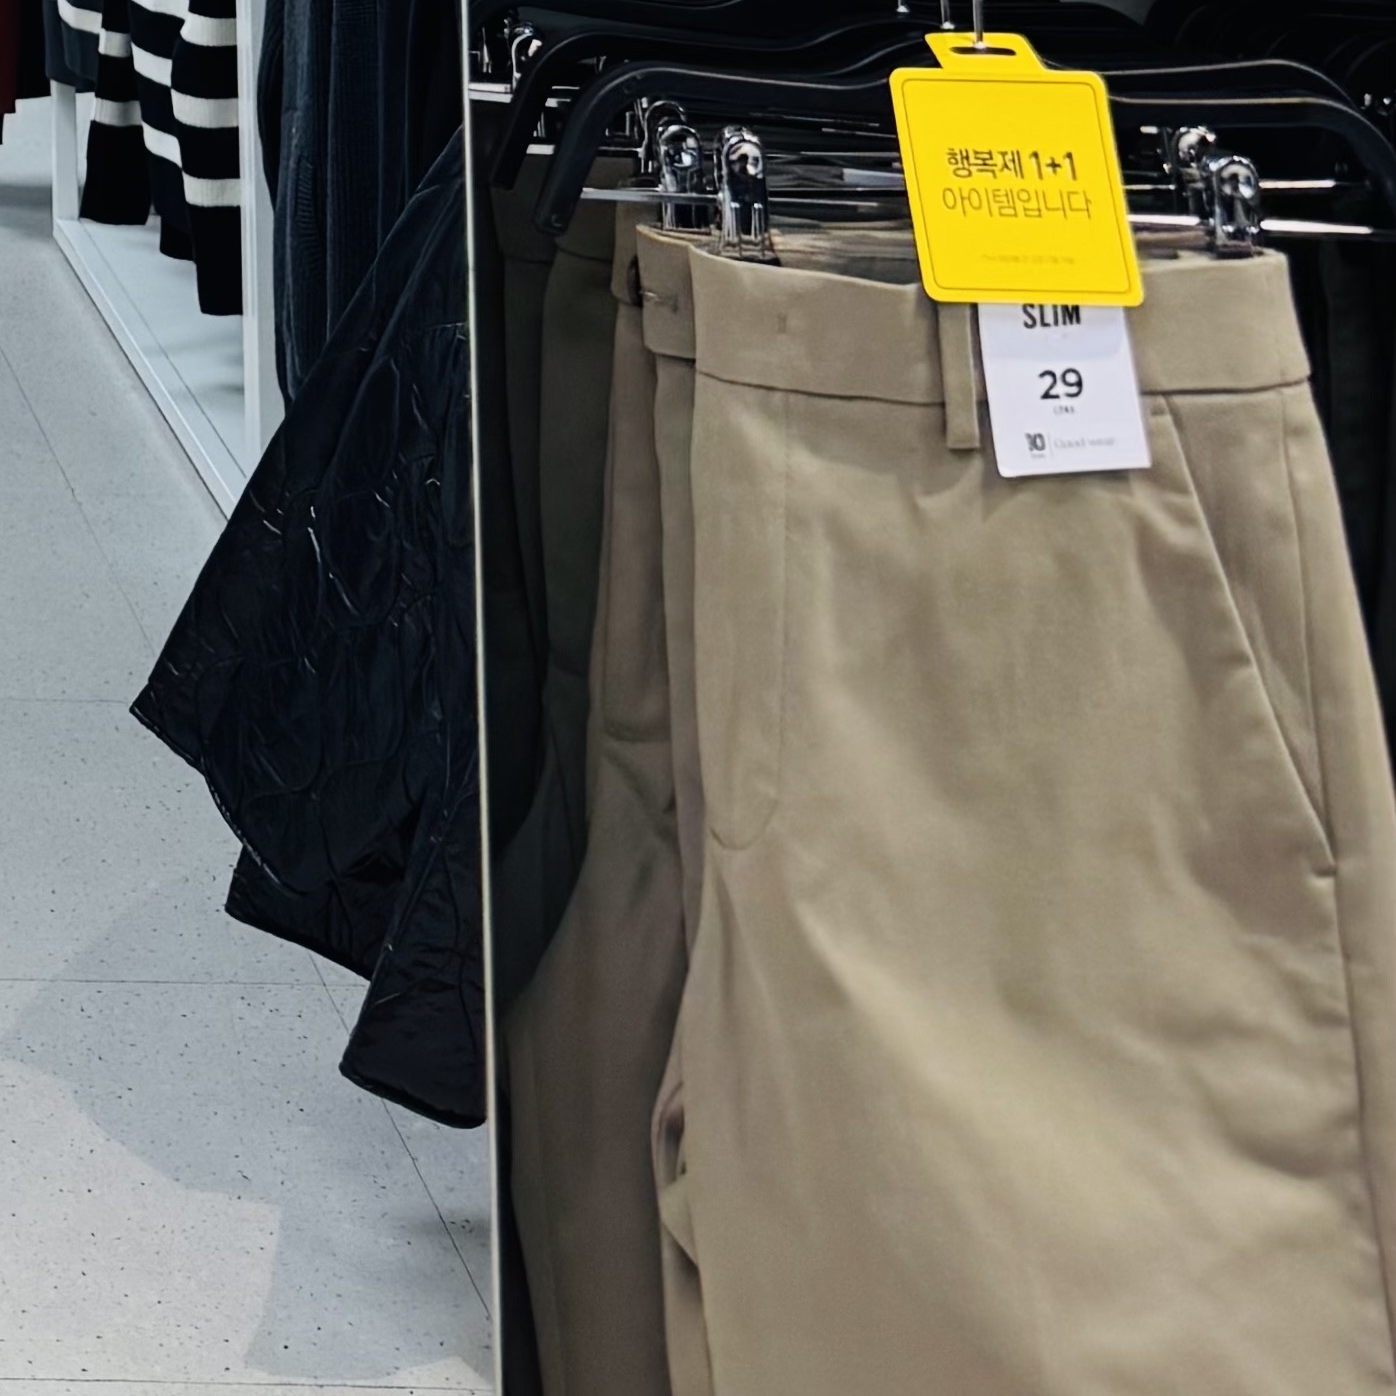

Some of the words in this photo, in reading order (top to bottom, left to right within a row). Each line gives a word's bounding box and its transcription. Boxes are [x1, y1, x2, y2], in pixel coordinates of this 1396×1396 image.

[945, 147, 1025, 180] 행복제
[1028, 150, 1078, 182] 1+1
[942, 186, 1093, 220] 아이템입니다
[1022, 303, 1082, 330] SLIM
[1038, 367, 1084, 400] 29
